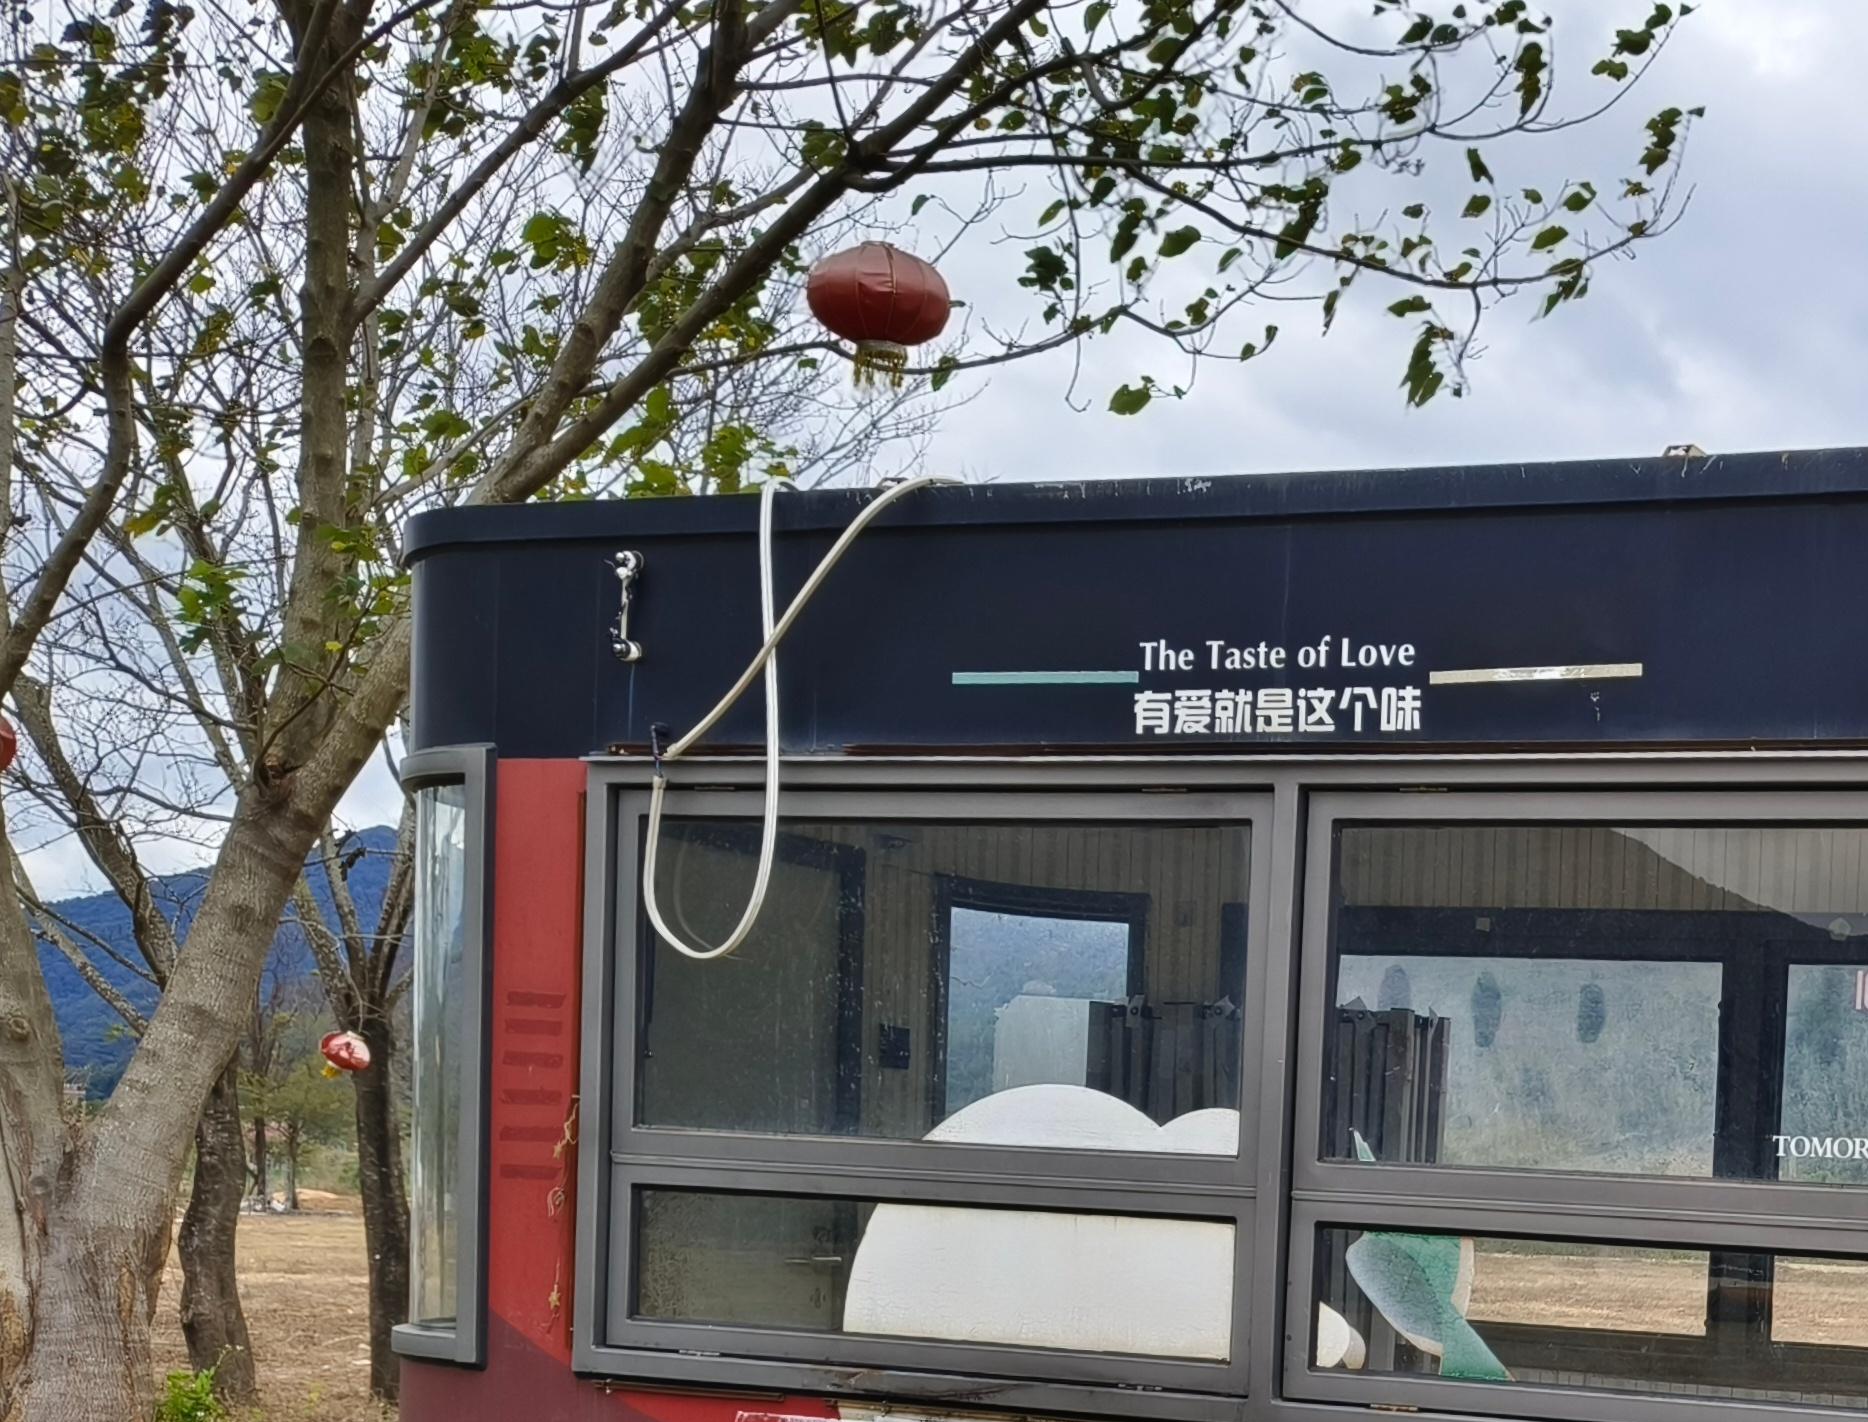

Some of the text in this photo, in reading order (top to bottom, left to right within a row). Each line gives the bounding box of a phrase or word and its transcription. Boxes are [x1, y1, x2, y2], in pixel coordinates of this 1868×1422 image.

[1140, 635, 1416, 671] The Taste of Love
[1133, 686, 1421, 735] 有爱就是这个味
